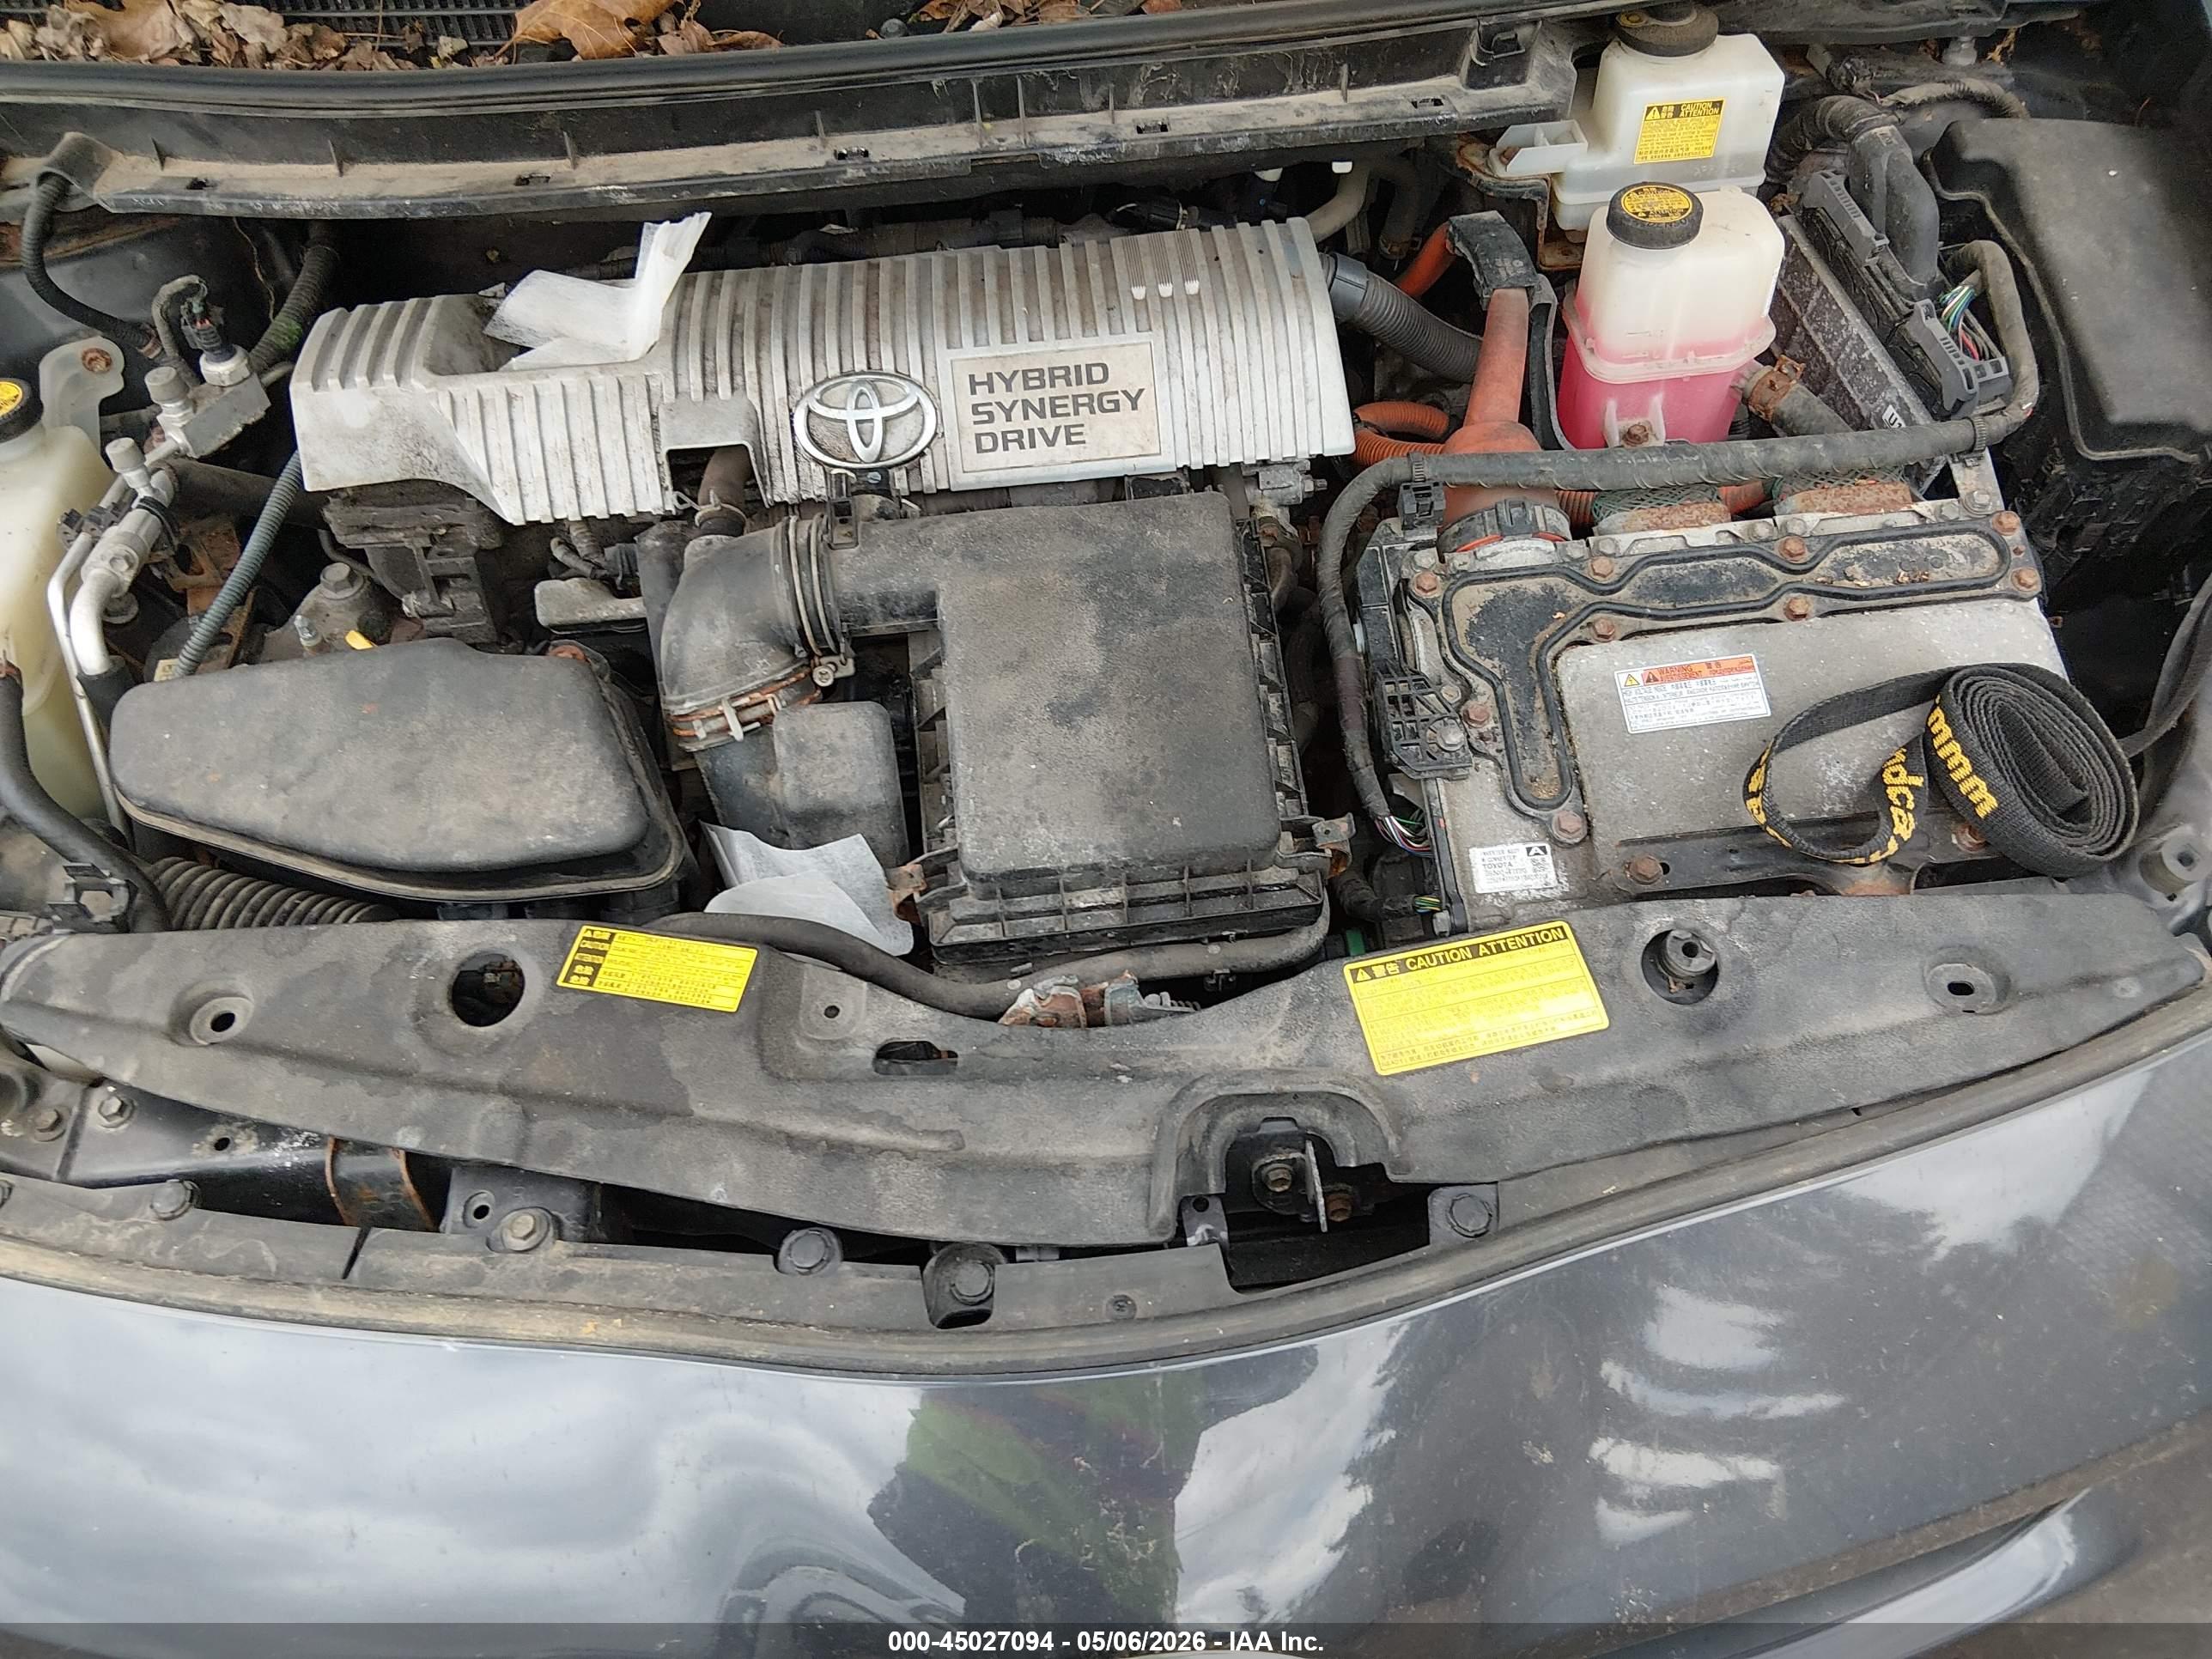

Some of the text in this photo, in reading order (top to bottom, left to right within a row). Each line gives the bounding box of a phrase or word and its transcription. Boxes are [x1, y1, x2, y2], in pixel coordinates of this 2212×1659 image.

[1679, 107, 1719, 118] ATTENTION
[1680, 102, 1712, 111] CAUTION
[968, 362, 1109, 395] HYBRID
[971, 388, 1146, 425] SYNERGY
[974, 423, 1086, 454] DRIVE
[1658, 665, 1692, 676] WARNING
[1406, 927, 1565, 971] CAUTION ATTENTION
[1371, 960, 1401, 979] 警告
